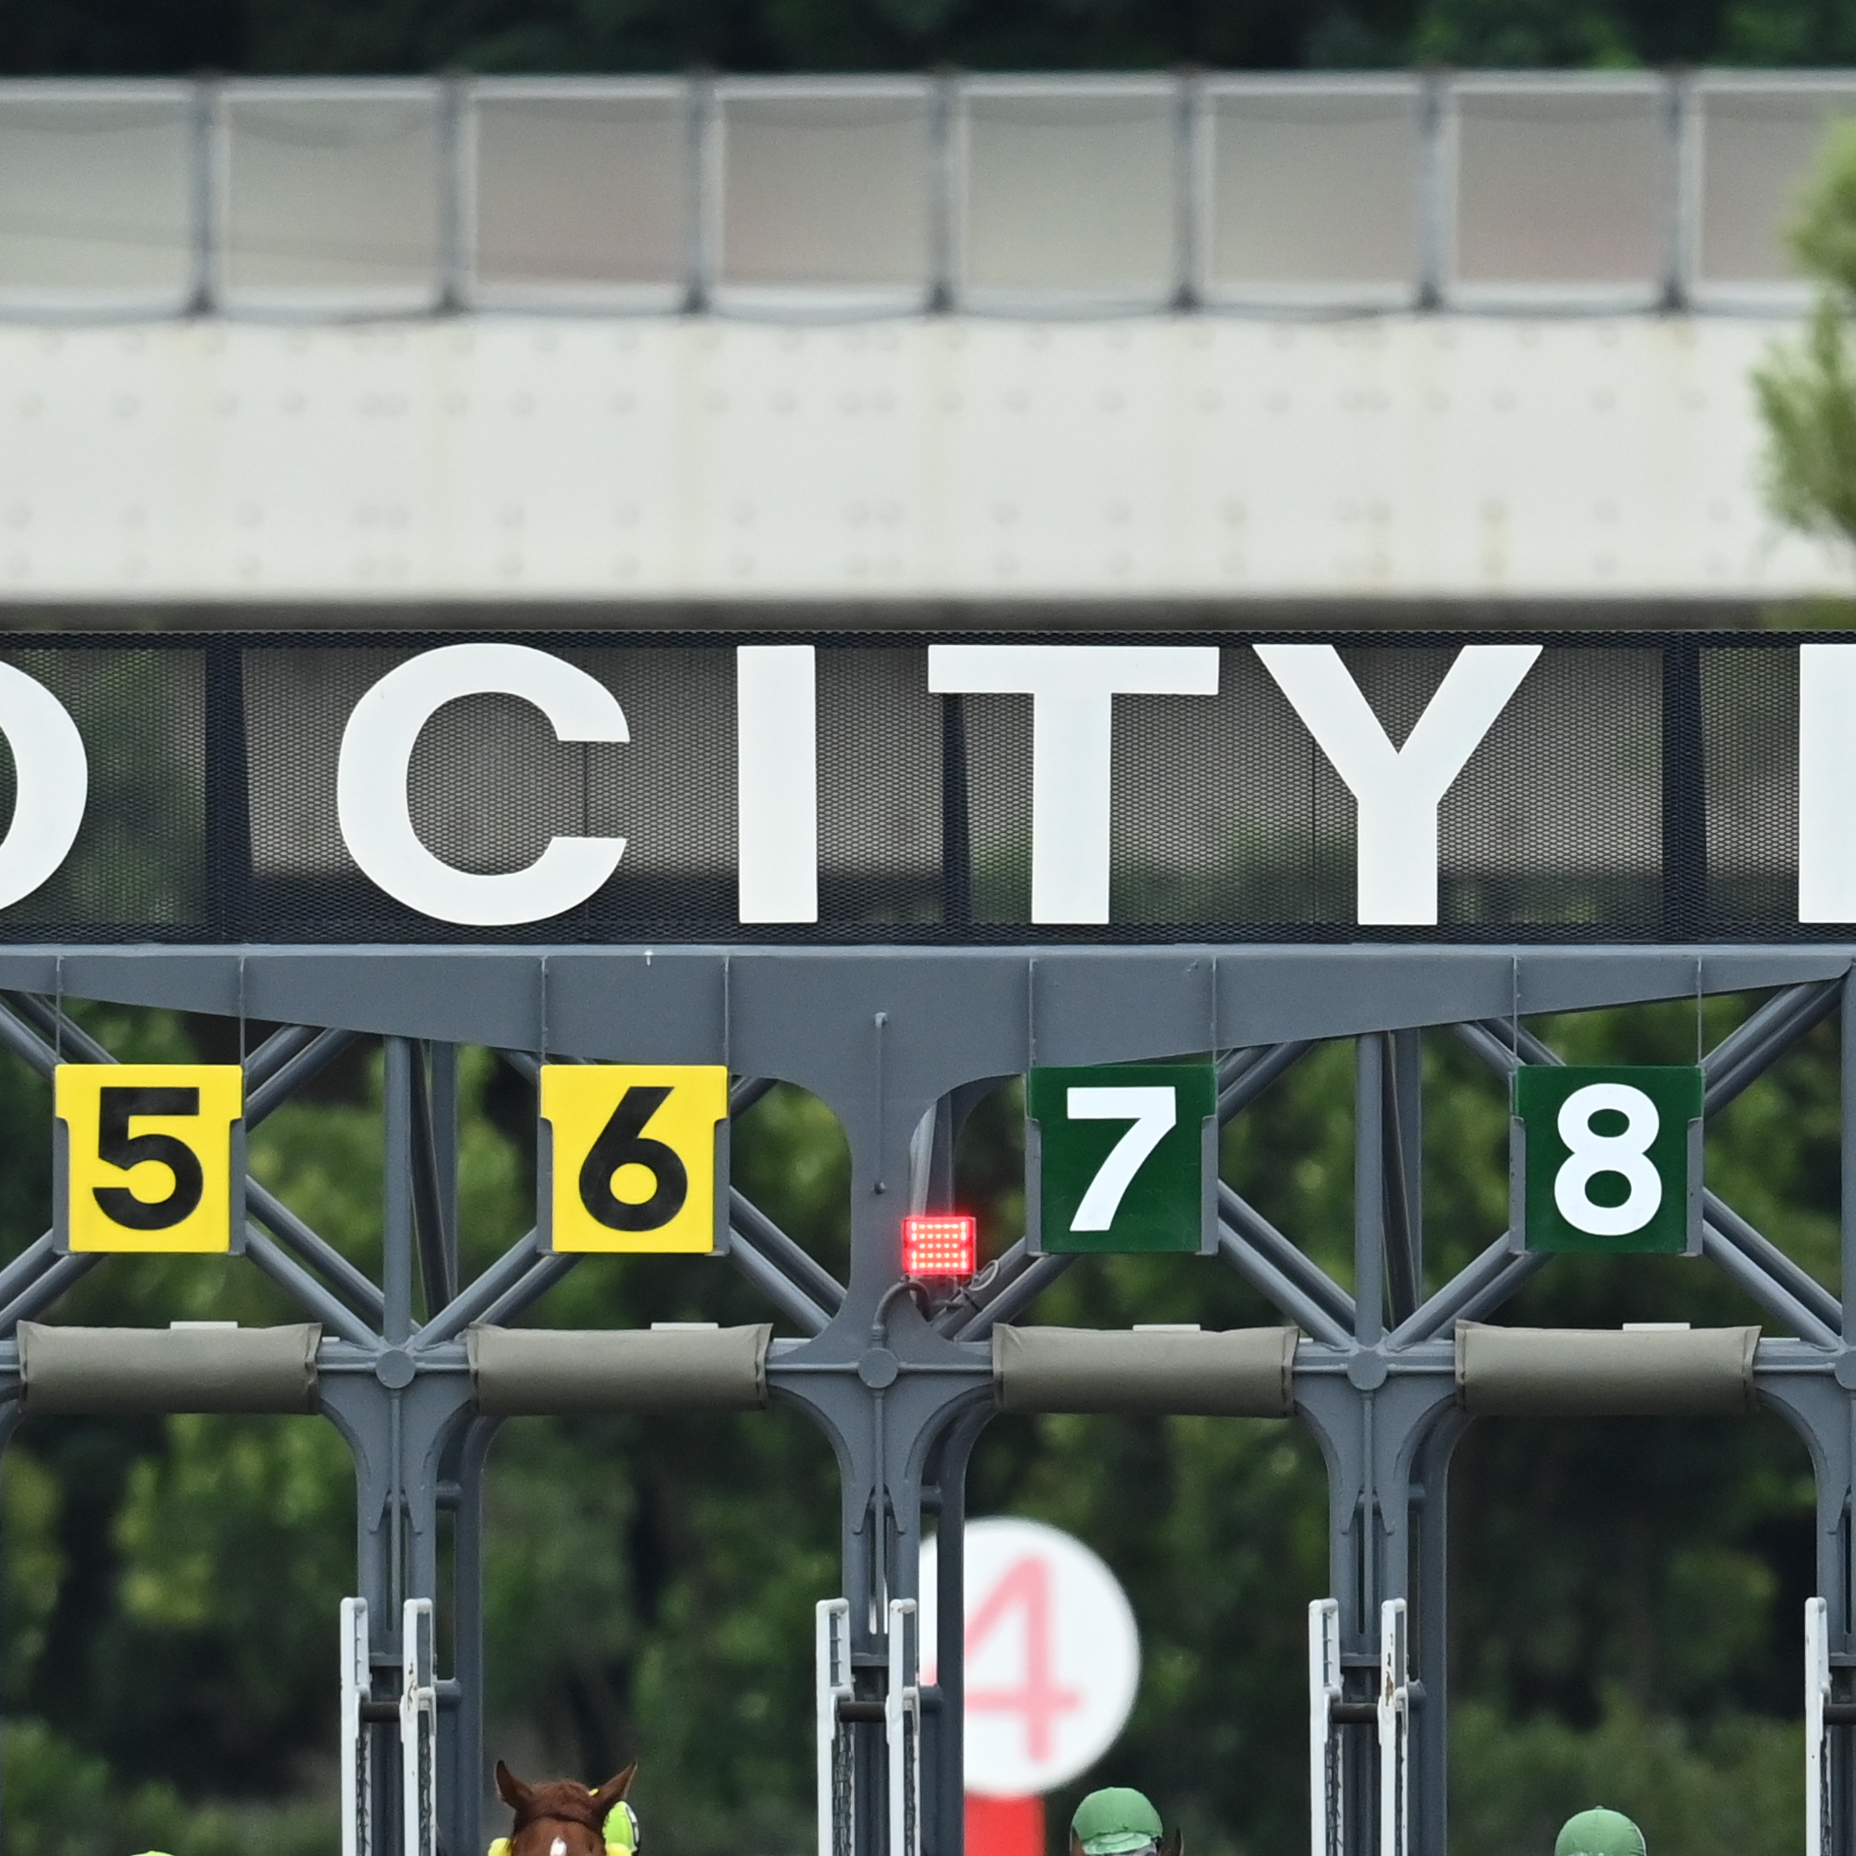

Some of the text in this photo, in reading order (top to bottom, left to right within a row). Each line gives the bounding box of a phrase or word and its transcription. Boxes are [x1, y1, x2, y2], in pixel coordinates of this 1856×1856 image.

[336, 643, 1544, 926] CITY
[92, 1086, 203, 1231] 5
[579, 1086, 688, 1232] 6
[1067, 1086, 1176, 1232] 7
[1554, 1083, 1662, 1236] 8
[920, 1553, 1082, 1763] 4
